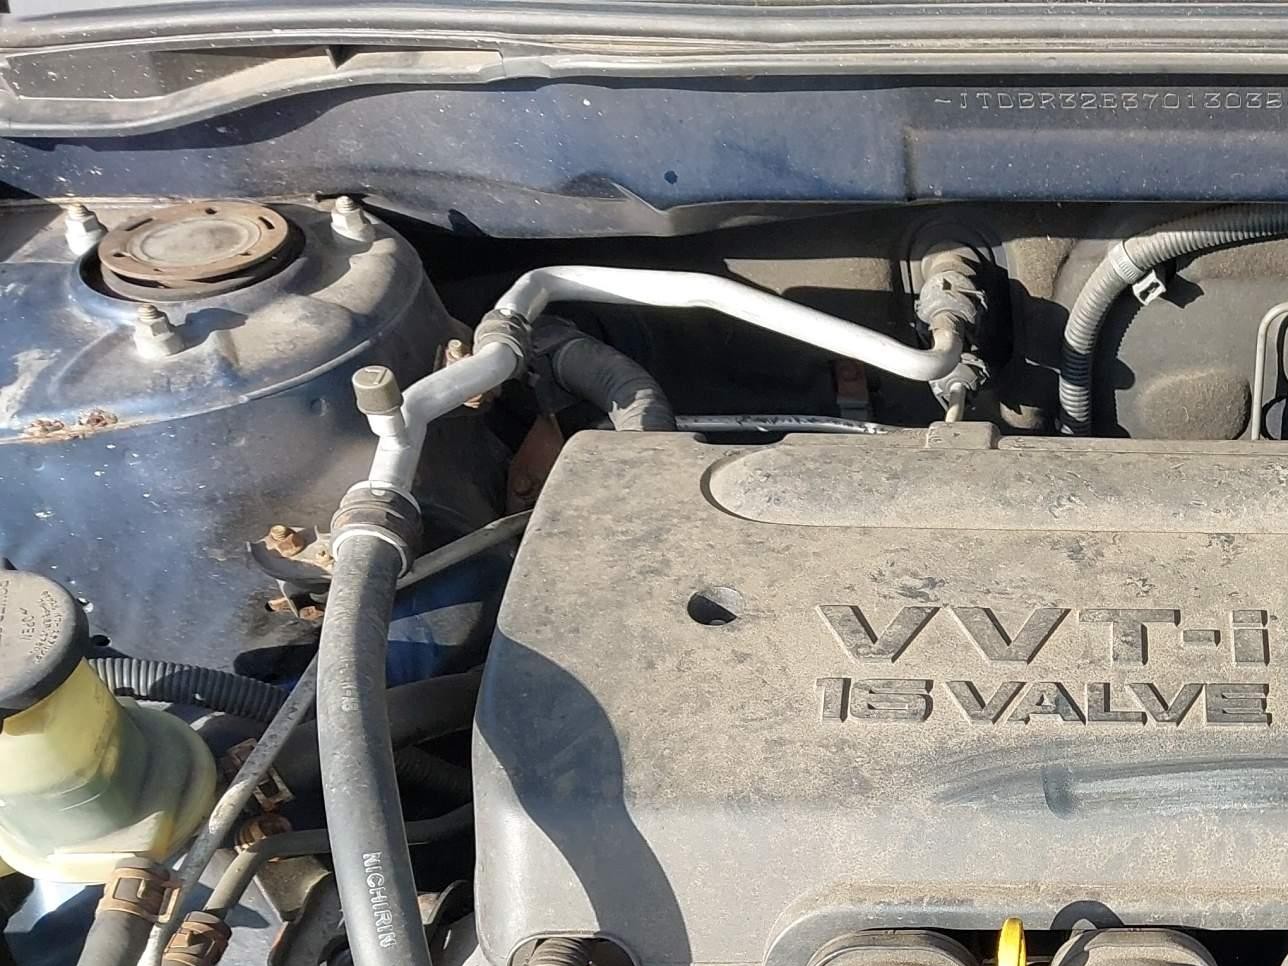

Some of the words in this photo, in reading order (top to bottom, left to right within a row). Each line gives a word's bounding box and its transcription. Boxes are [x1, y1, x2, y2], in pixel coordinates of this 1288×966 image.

[817, 604, 1272, 667] VVT-i
[816, 678, 933, 723] 16
[946, 681, 1273, 727] VALVE
[362, 852, 395, 948] NICHIRIN
